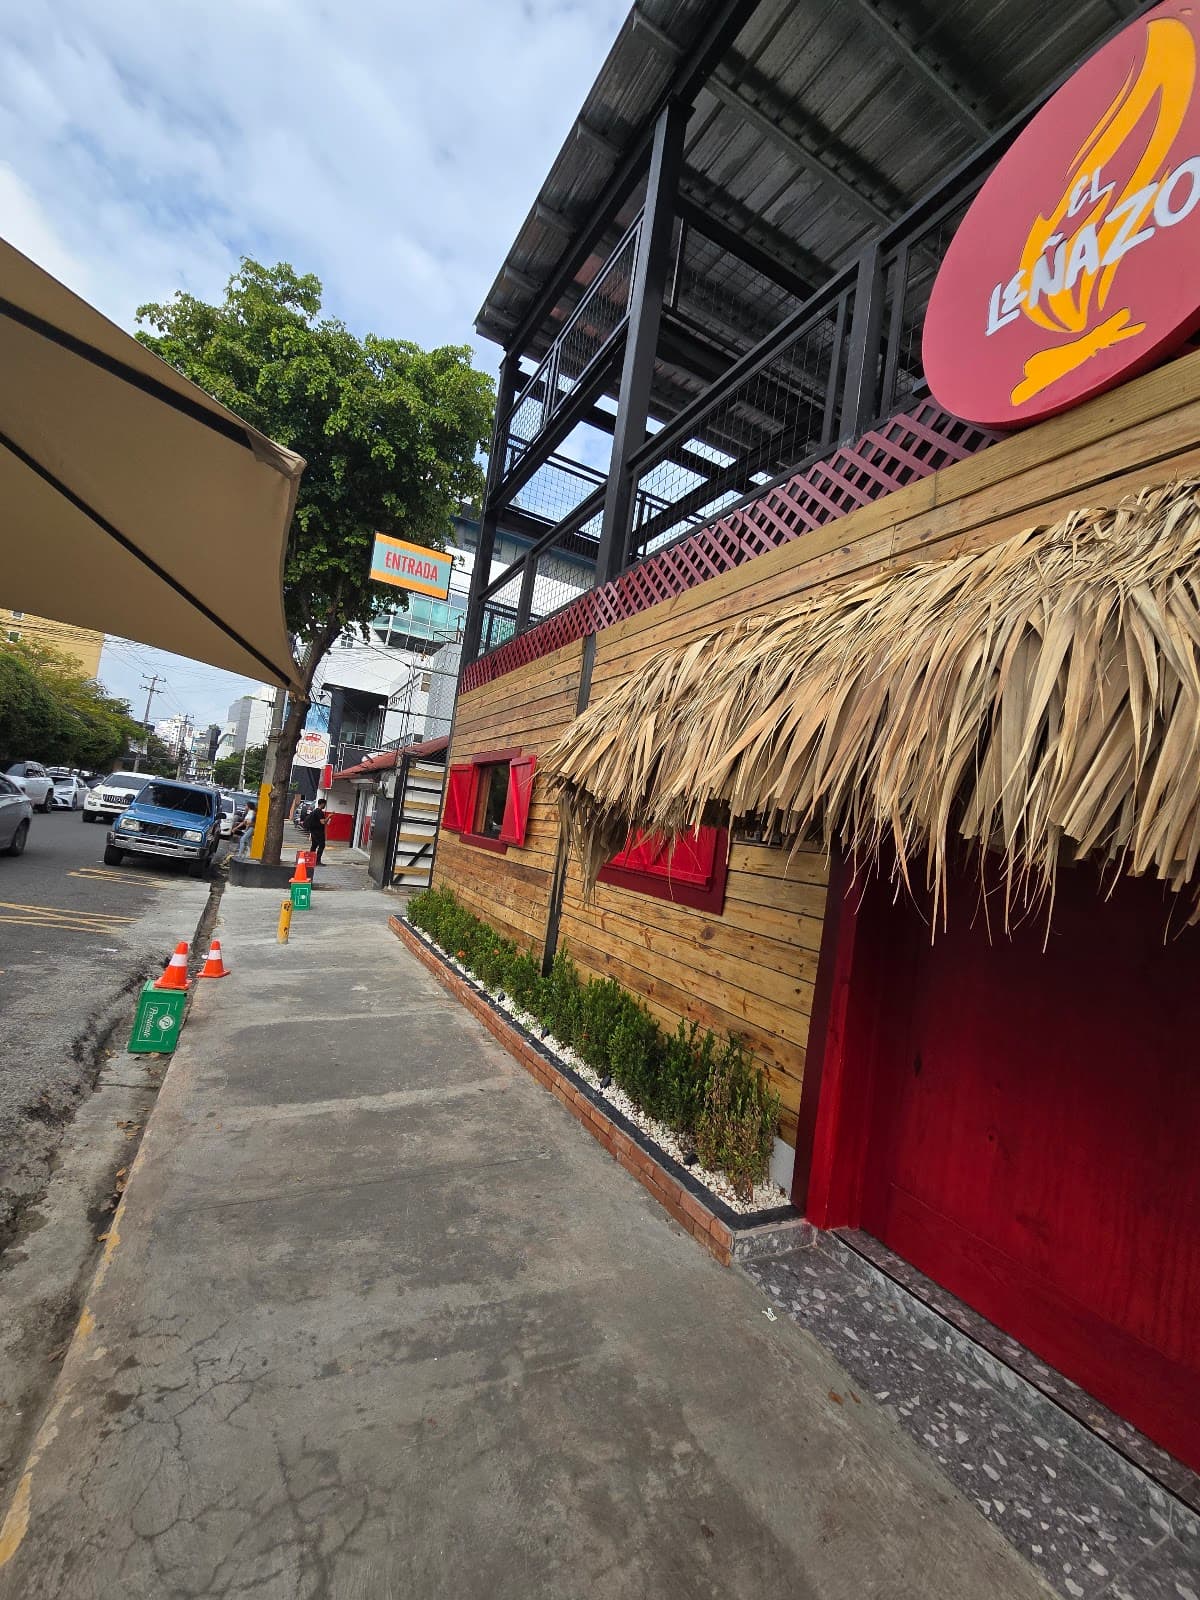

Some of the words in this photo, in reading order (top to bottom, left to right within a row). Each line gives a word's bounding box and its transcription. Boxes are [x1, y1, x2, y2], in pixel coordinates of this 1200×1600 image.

[1067, 166, 1116, 217] EL
[984, 155, 1200, 336] LEÑAZO
[385, 551, 438, 582] ENTRADA
